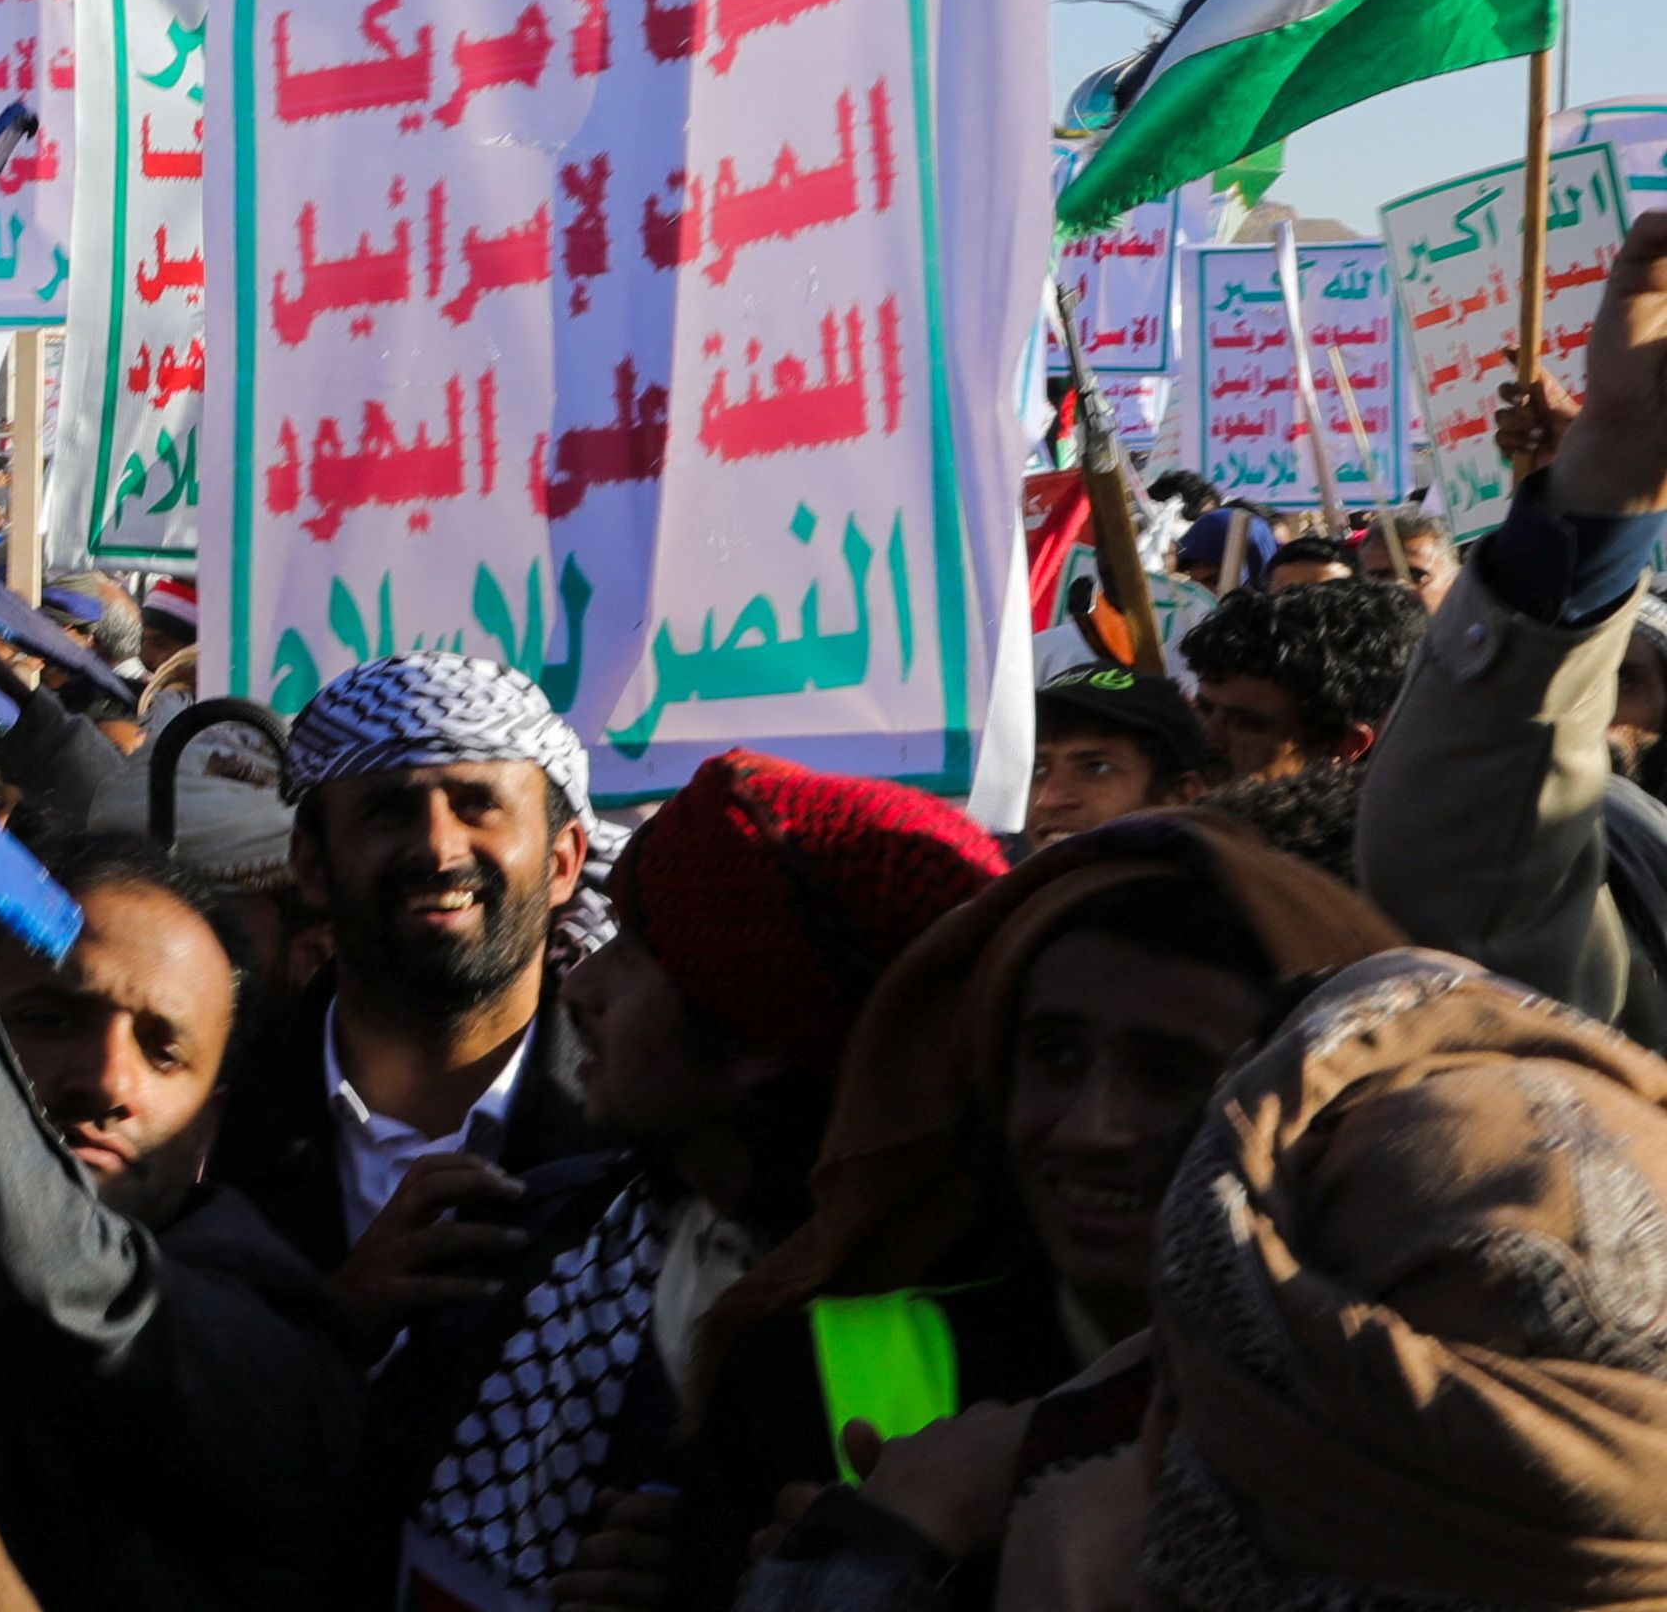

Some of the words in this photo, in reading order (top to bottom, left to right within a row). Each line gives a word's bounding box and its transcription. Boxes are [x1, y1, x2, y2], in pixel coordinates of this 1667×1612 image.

[271, 149, 613, 349] لإسرائيل
[643, 78, 896, 286] الموت
[1403, 182, 1505, 285] أكبر
[1323, 259, 1388, 300] الله
[268, 368, 497, 540] اليهود
[528, 357, 670, 519] على
[697, 291, 905, 466] اللعنة
[604, 504, 914, 759] النصر
